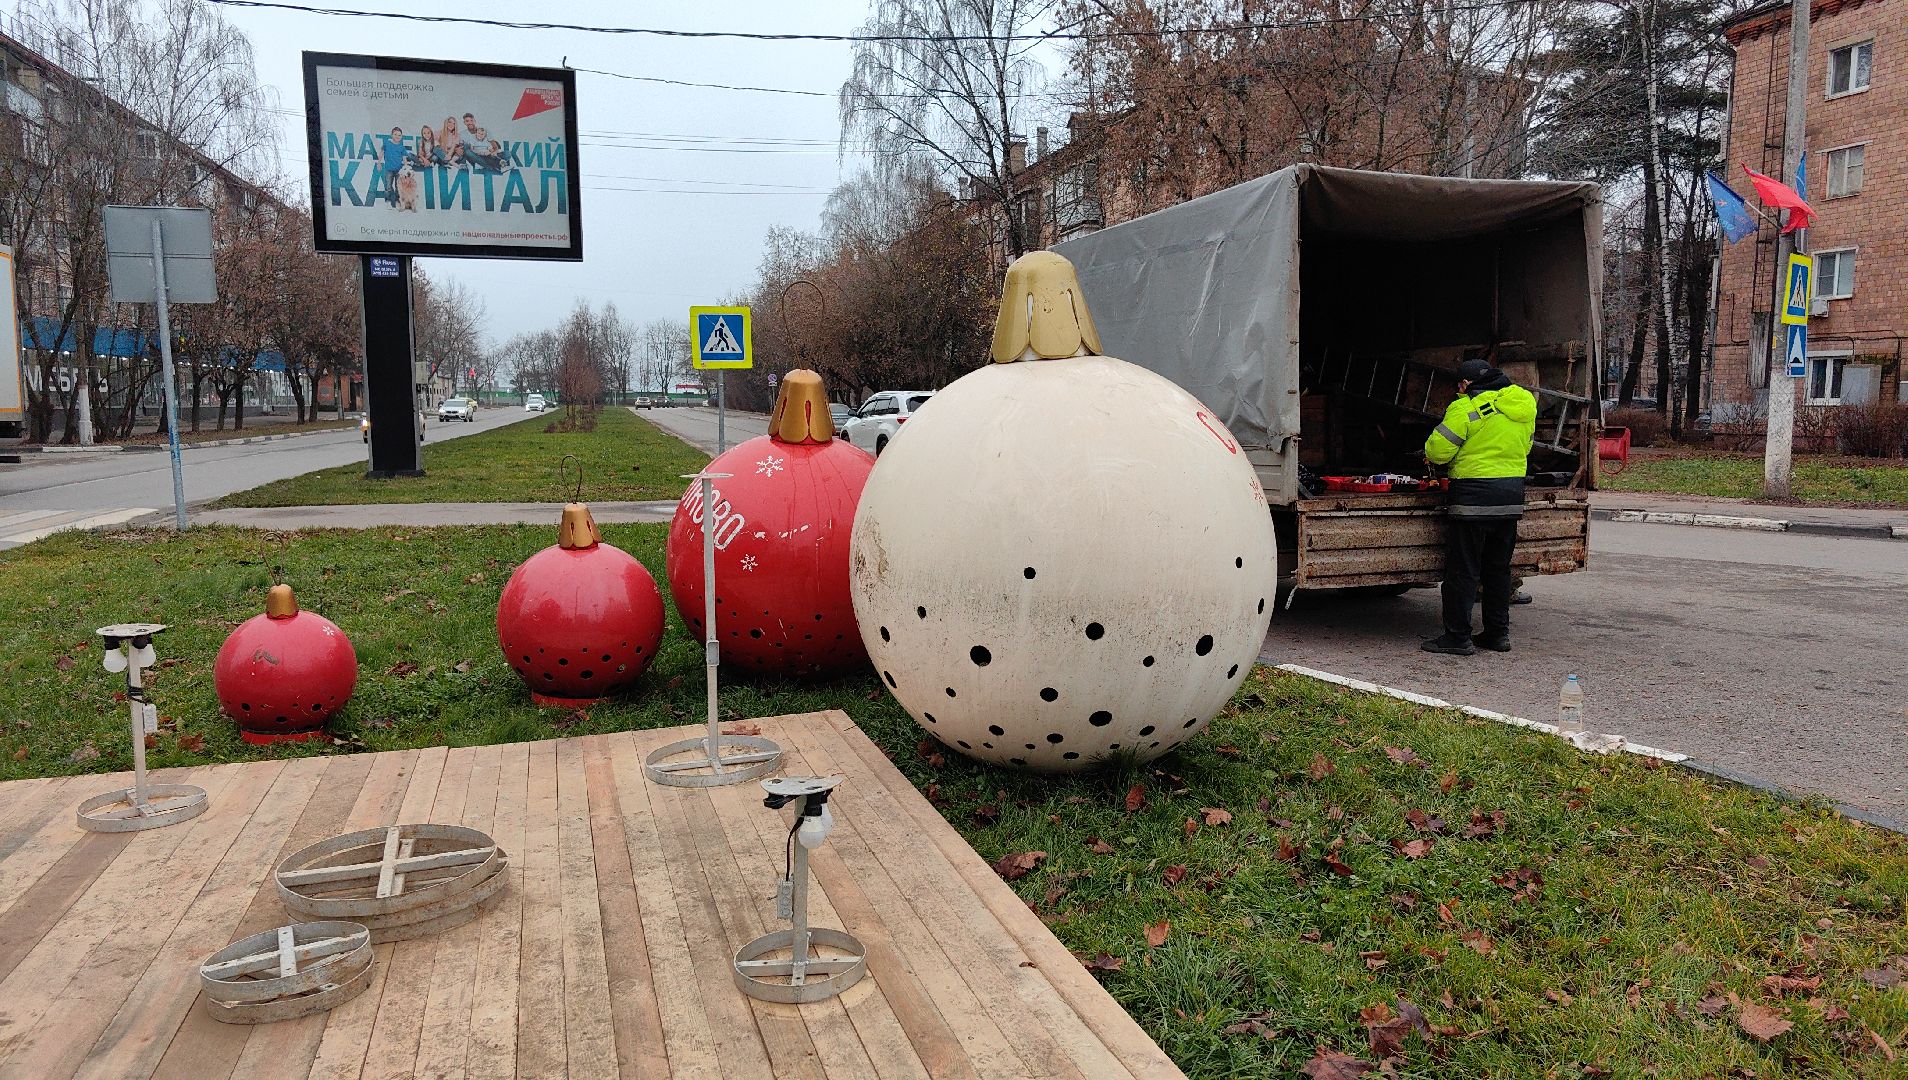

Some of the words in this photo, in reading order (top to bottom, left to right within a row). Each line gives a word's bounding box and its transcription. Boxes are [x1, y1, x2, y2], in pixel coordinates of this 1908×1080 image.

[326, 78, 373, 88] Большая
[376, 82, 434, 92] поддержка
[326, 88, 360, 97] семей
[370, 91, 409, 100] детьми
[326, 131, 566, 170] МАТЕКИЙ
[328, 160, 568, 215] КАПИТАЛ
[360, 226, 376, 235] Все
[402, 229, 449, 238] поддержки
